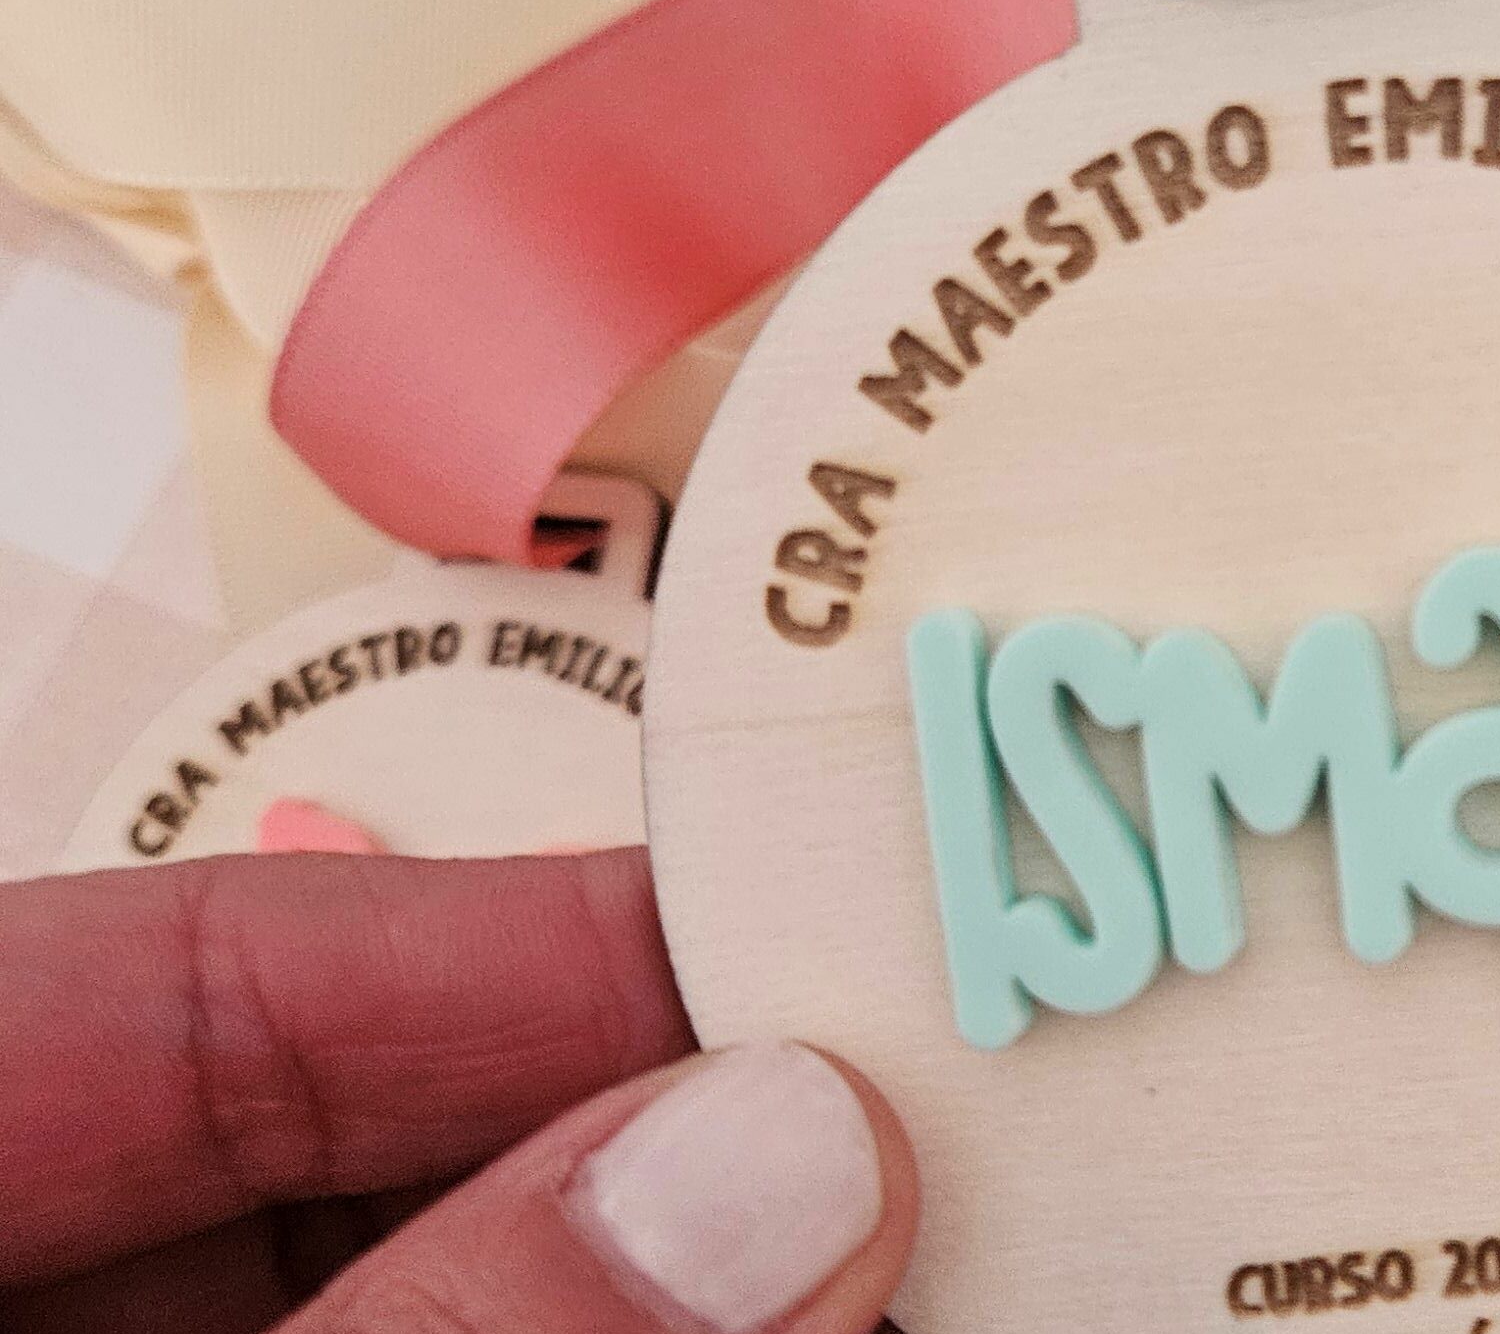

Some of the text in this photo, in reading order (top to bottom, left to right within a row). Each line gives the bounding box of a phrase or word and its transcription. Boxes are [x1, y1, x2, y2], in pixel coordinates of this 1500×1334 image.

[763, 460, 897, 648] CRA
[858, 102, 1270, 433] MAESTRO
[128, 757, 218, 857] CRA
[216, 621, 462, 756] MAESTRO
[1225, 1249, 1416, 1317] CURSO
